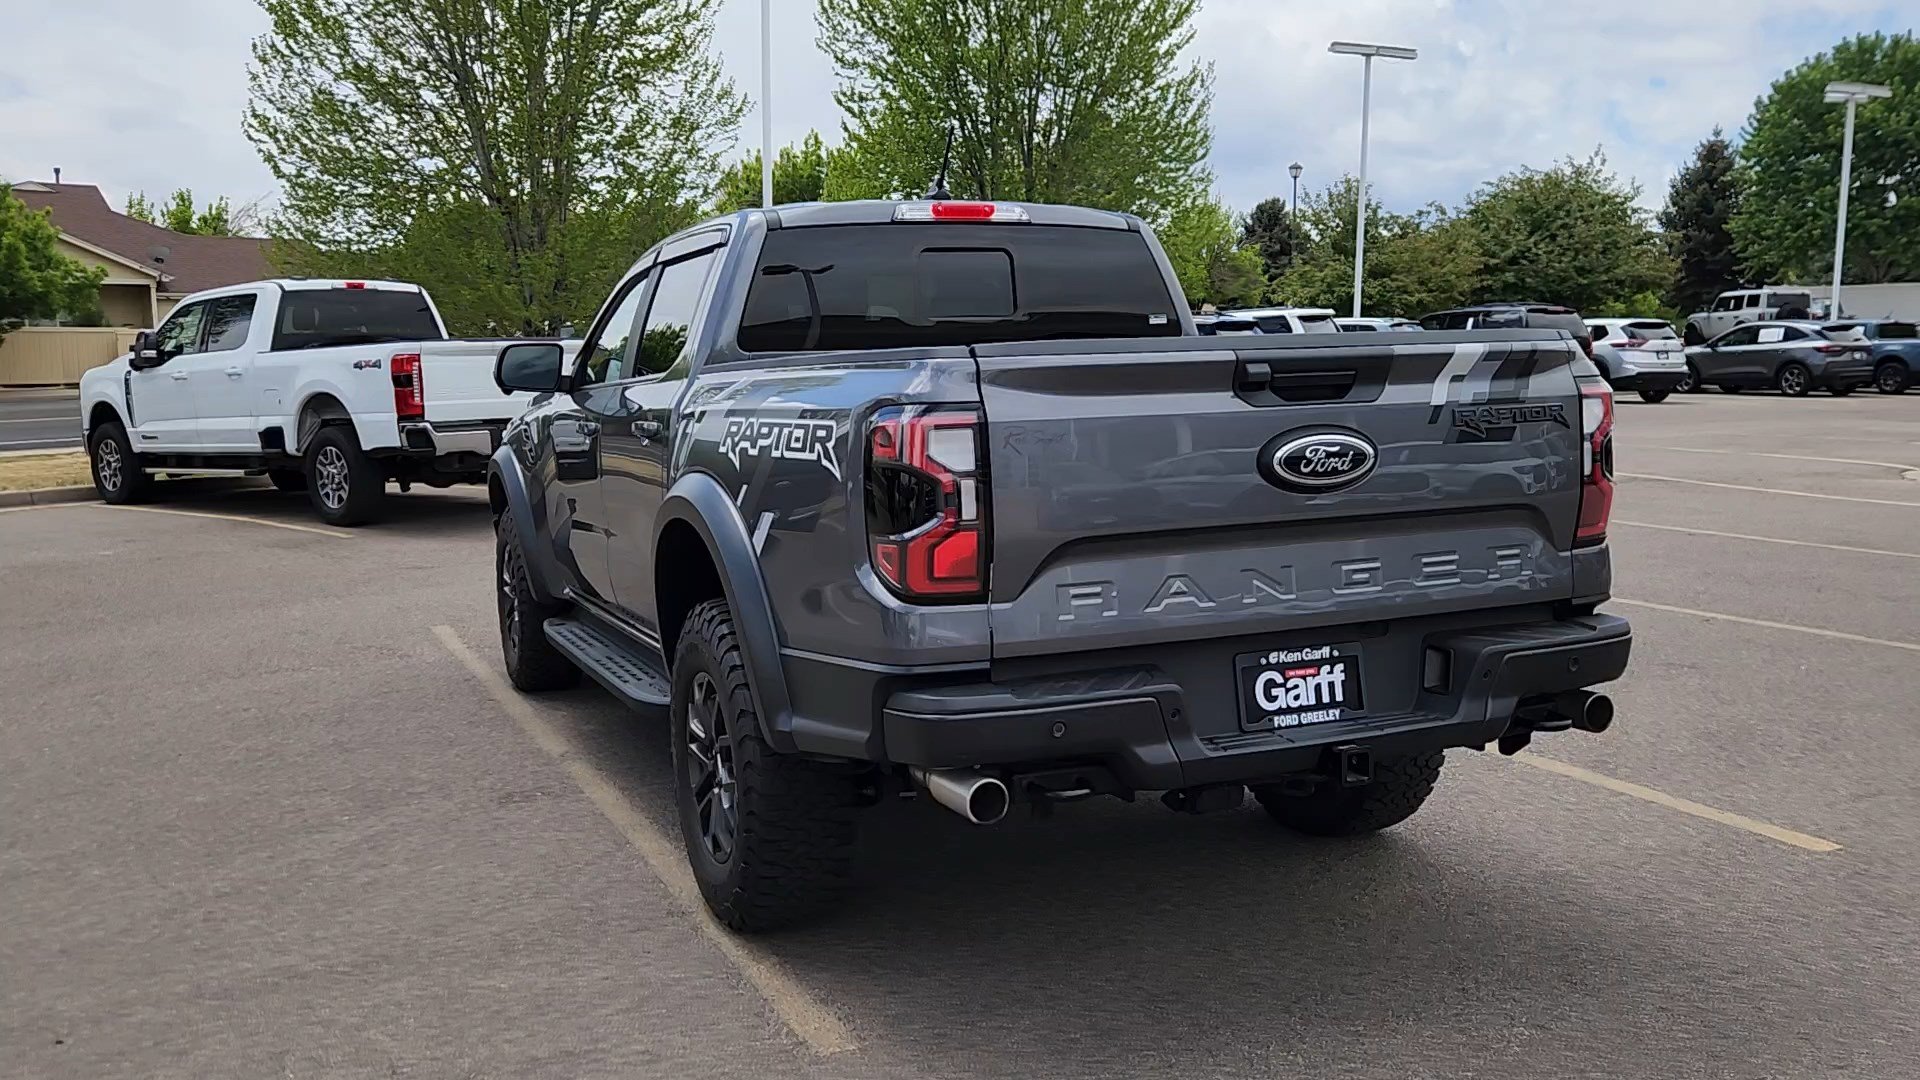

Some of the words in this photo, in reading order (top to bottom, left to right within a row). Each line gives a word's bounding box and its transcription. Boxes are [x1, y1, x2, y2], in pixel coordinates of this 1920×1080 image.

[1453, 403, 1571, 438] RAPTOR
[718, 417, 841, 482] RAPTOR
[1300, 446, 1353, 473] Ford
[1056, 545, 1533, 621] RANGER
[1279, 651, 1301, 663] Ken
[1302, 646, 1330, 660] Garff
[1255, 663, 1345, 711] Garff
[1273, 716, 1299, 728] FORD
[1300, 709, 1340, 725] GREELEY
